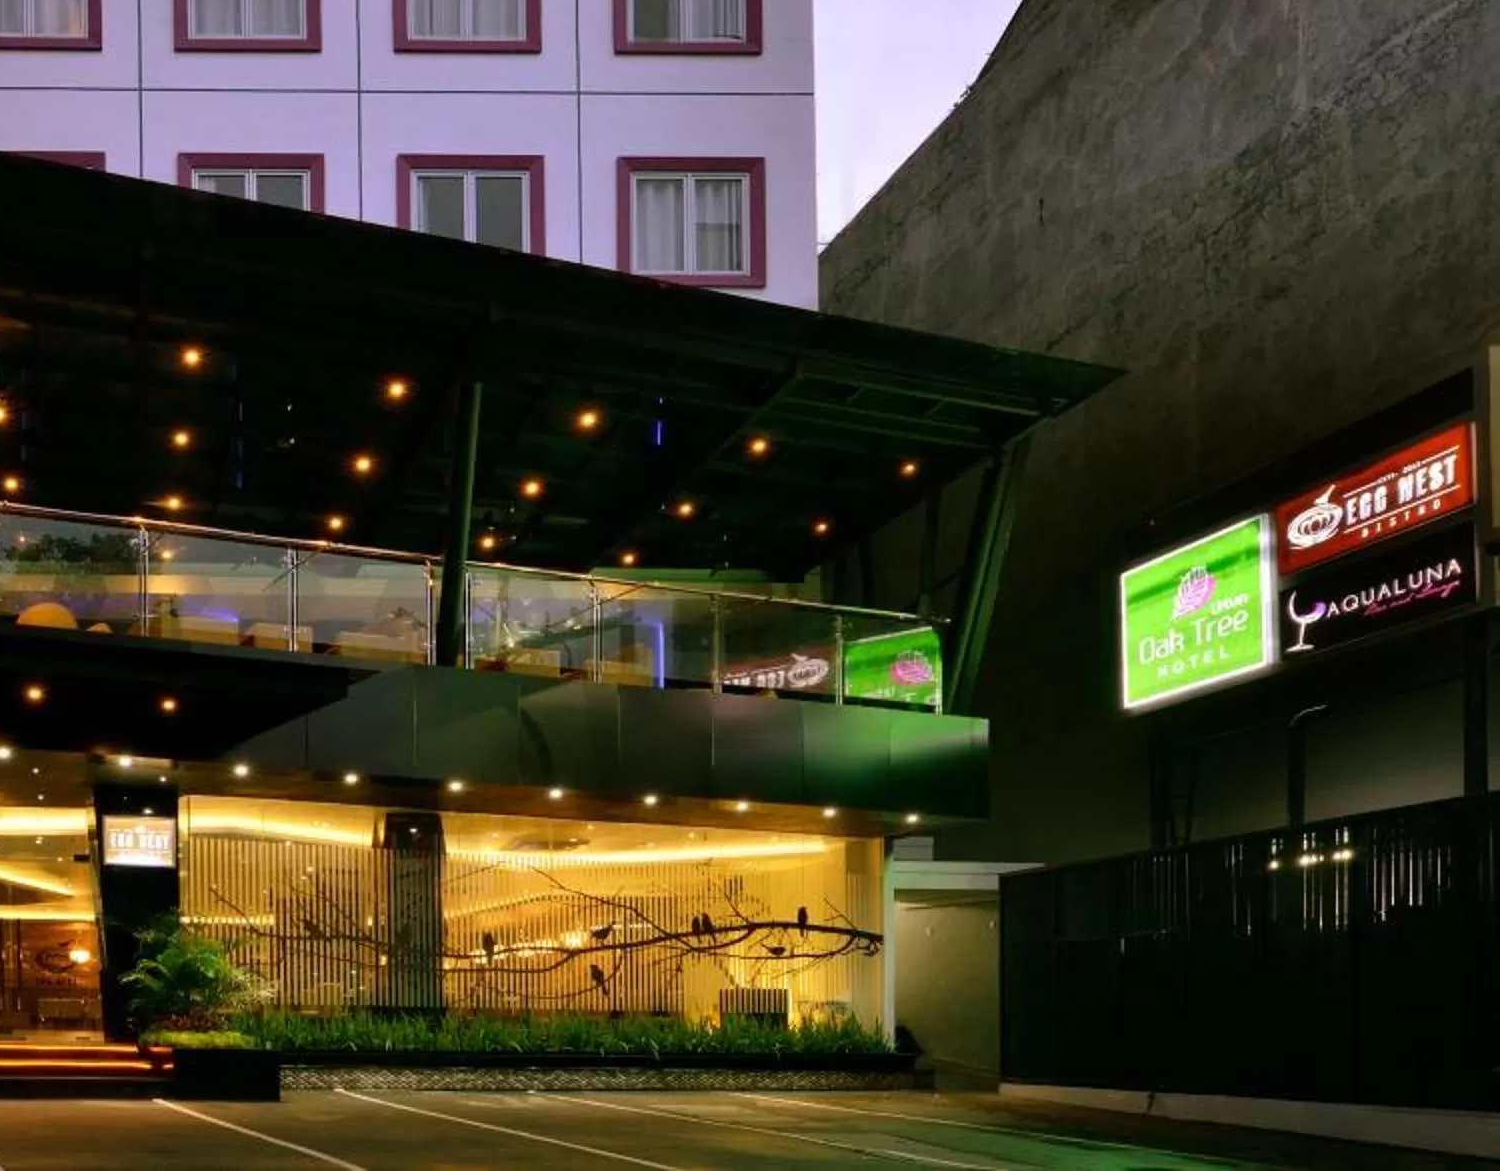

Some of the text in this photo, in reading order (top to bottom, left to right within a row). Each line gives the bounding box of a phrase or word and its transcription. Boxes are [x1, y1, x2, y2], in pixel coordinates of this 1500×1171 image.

[1344, 484, 1388, 526] EGG
[1397, 454, 1458, 506] NEST
[1360, 497, 1442, 539] BISTRO
[1325, 557, 1463, 619] AQUALUNA
[1138, 609, 1250, 666] Oak Tree
[1156, 644, 1231, 680] HOTEL
